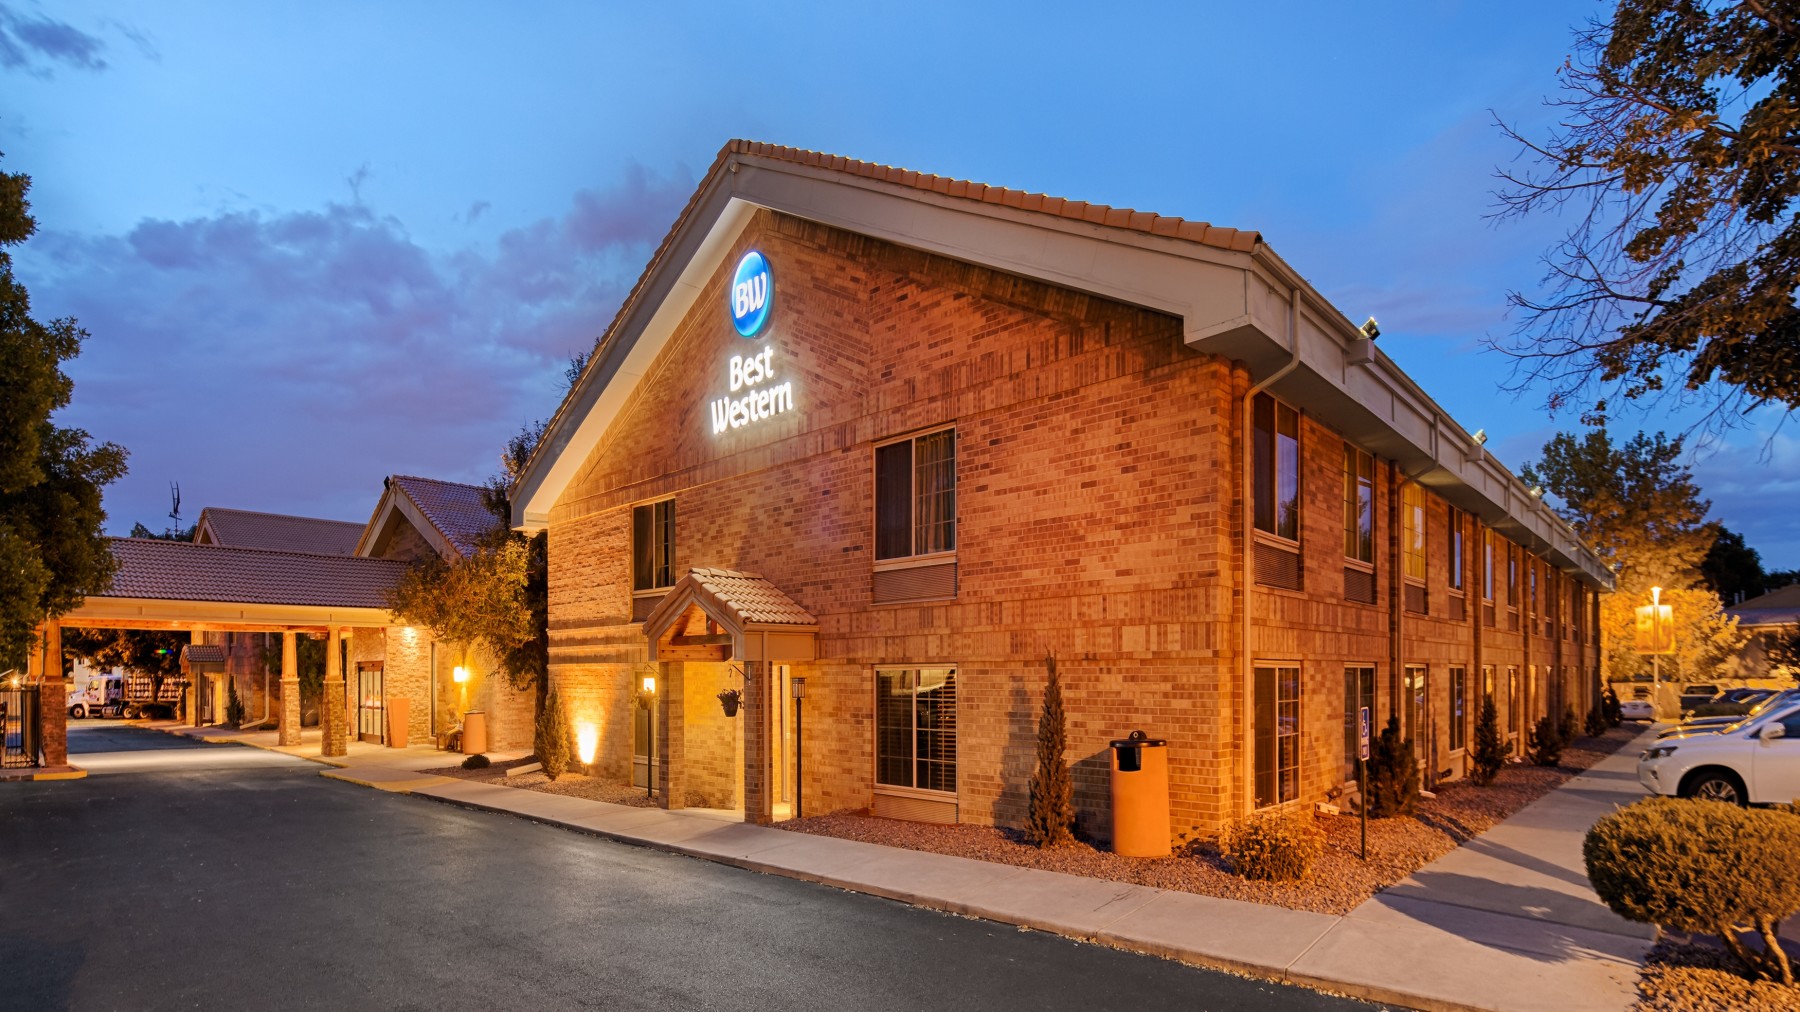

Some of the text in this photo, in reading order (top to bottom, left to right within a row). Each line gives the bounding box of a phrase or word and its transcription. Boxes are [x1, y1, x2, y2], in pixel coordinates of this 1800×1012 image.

[735, 272, 767, 319] BW
[729, 345, 774, 392] Best
[711, 381, 793, 435] Western
